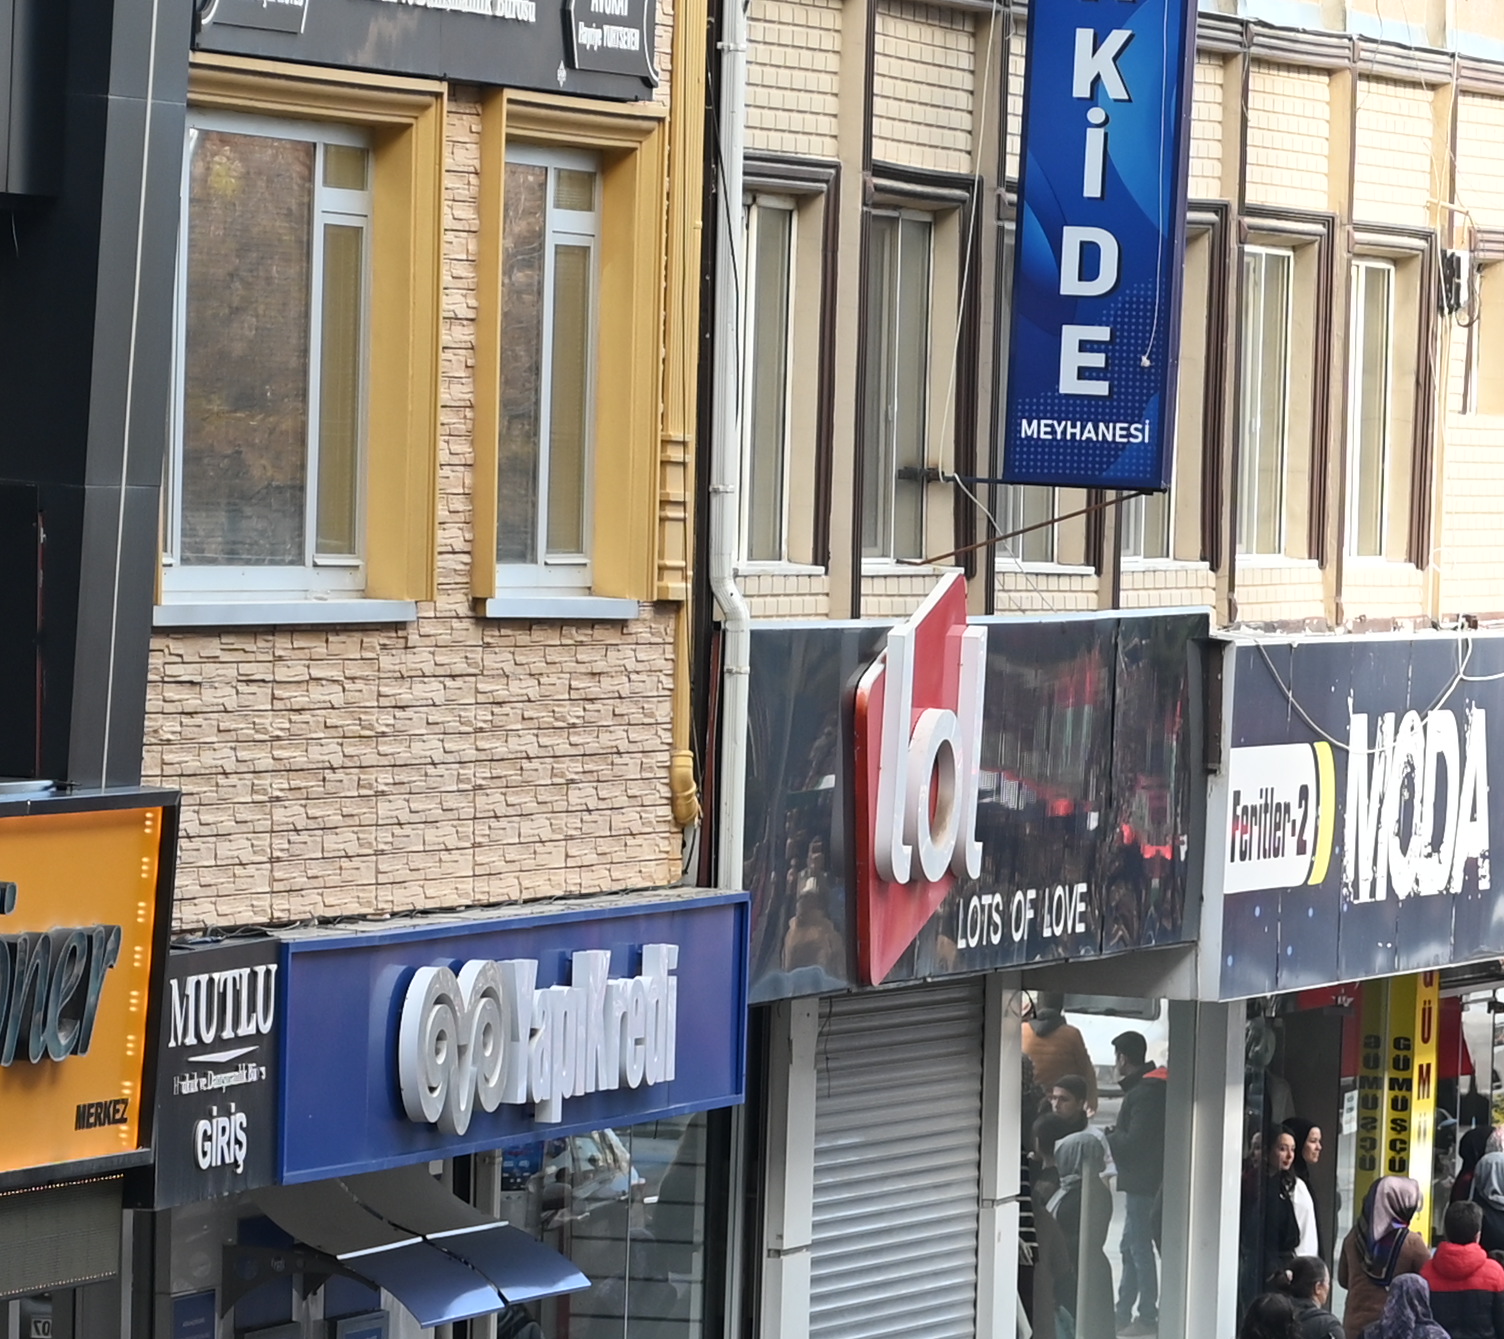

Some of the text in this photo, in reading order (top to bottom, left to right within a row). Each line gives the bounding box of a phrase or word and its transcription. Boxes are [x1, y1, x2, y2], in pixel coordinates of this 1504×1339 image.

[1020, 413, 1151, 445] MEYHANESİ
[1345, 705, 1489, 904] MODA
[956, 882, 1088, 950] LOTS OF LOVE
[168, 964, 278, 1047] MUTLU
[74, 1098, 129, 1132] MERKEZ
[196, 1102, 247, 1174] GİRİŞ
